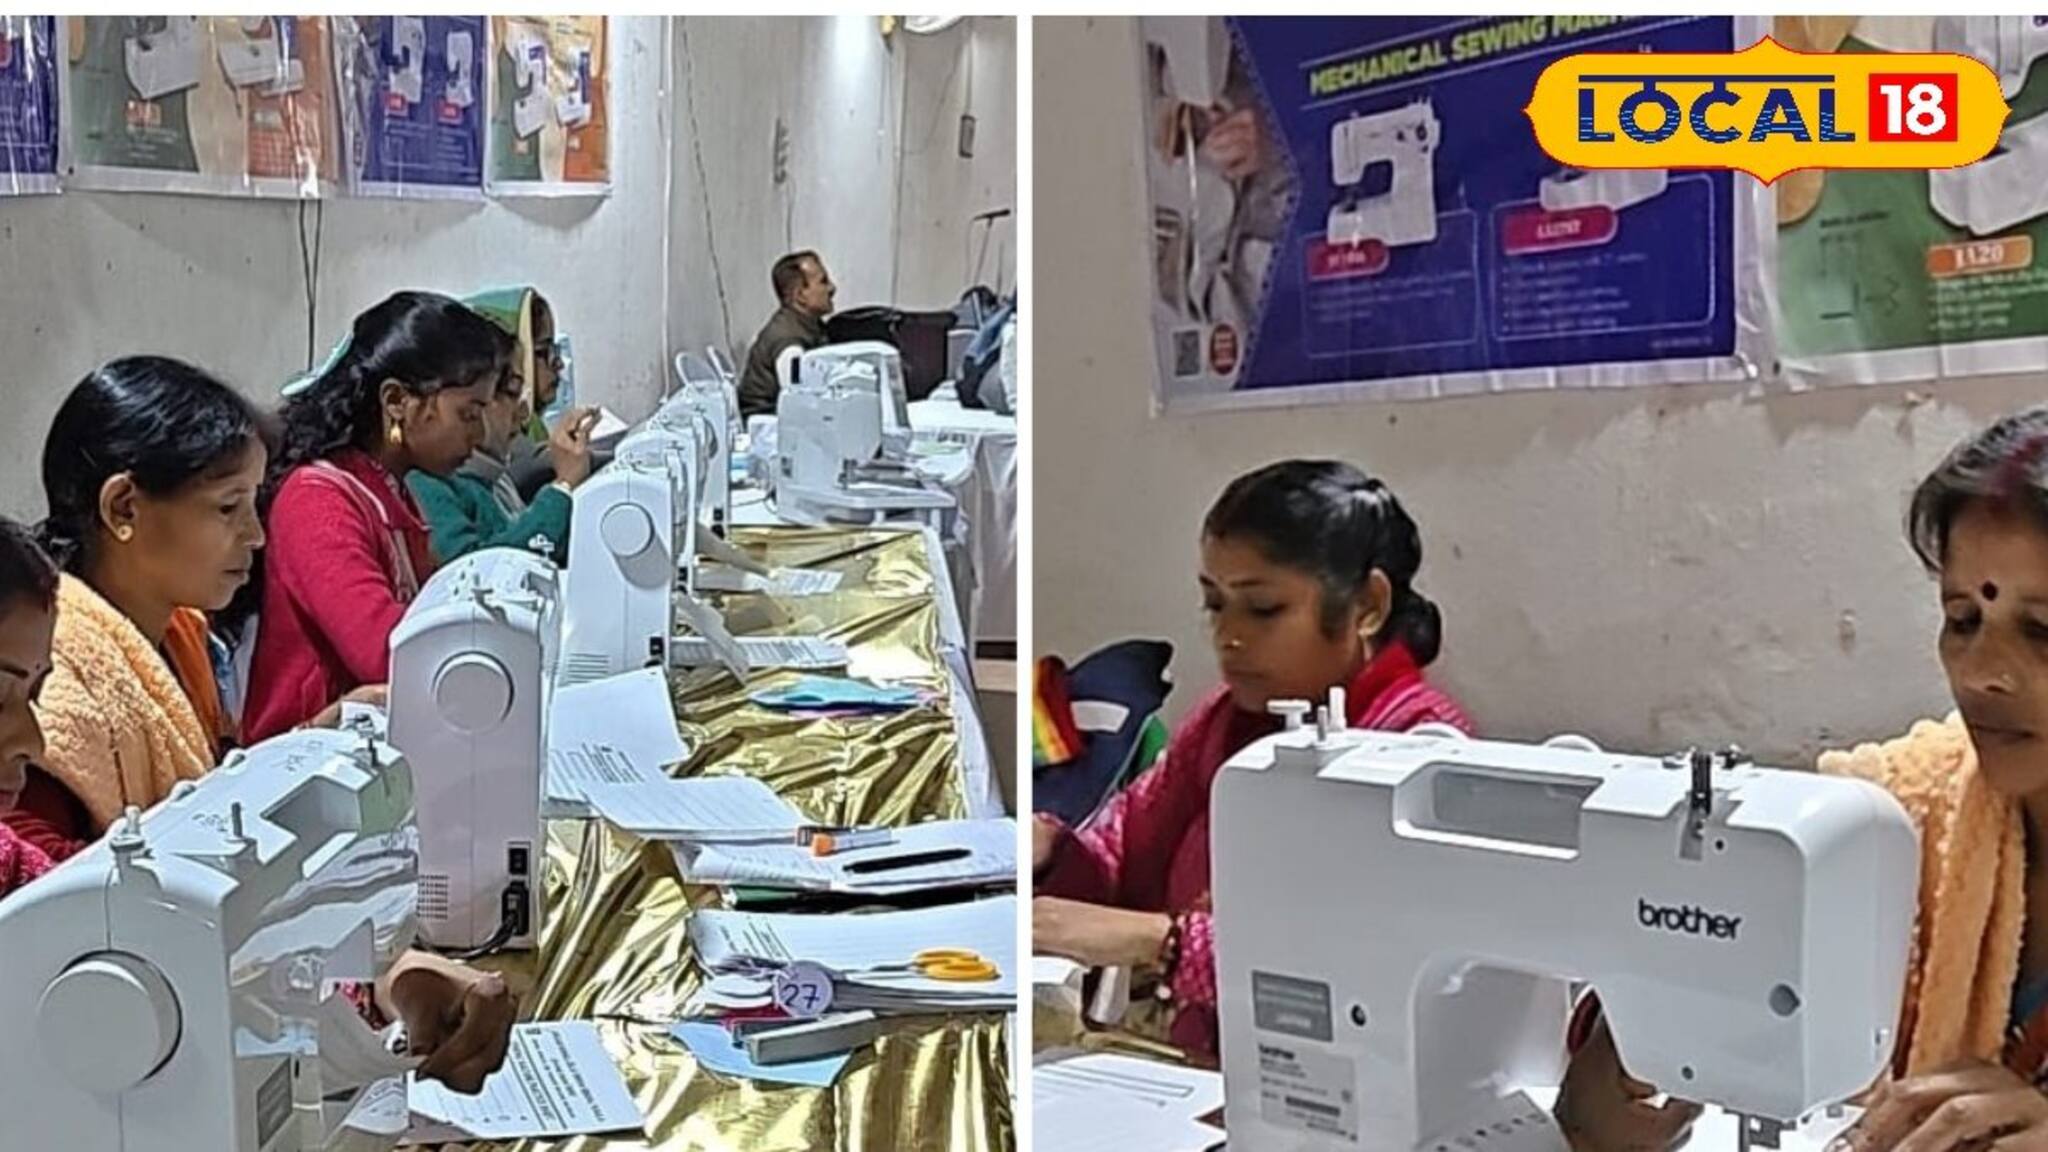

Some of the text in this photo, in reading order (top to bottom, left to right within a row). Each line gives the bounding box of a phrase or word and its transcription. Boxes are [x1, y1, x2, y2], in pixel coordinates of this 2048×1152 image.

[1310, 40, 1447, 96] MECHANICAL
[1451, 17, 1548, 62] SEWING
[1638, 897, 1742, 940] brother
[782, 983, 820, 1010] 27
